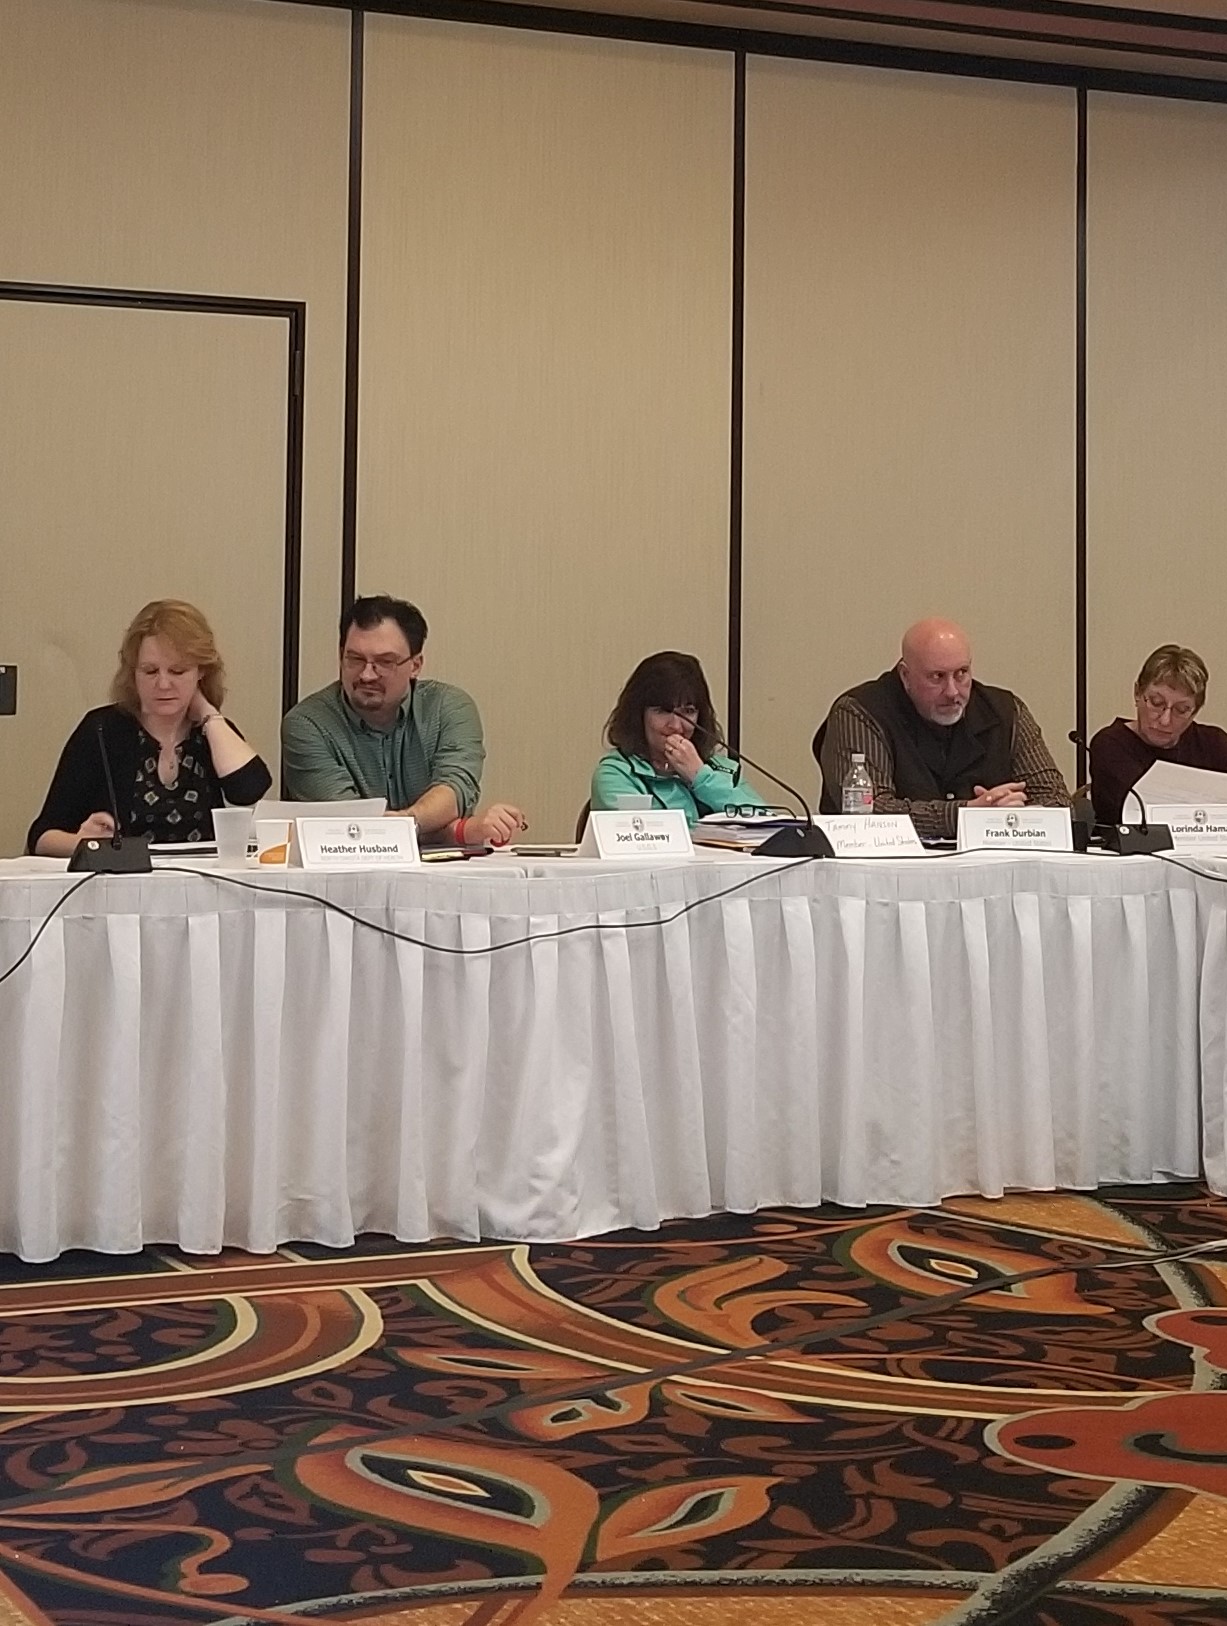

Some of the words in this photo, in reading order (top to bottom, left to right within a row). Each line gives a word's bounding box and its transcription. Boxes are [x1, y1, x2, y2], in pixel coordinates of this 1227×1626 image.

[985, 829, 1010, 837] Frank
[1012, 829, 1046, 837] Durbian
[1171, 825, 1204, 833] Lorinda
[616, 833, 633, 842] Joel
[320, 845, 357, 854] Heather
[359, 844, 399, 853] Husband
